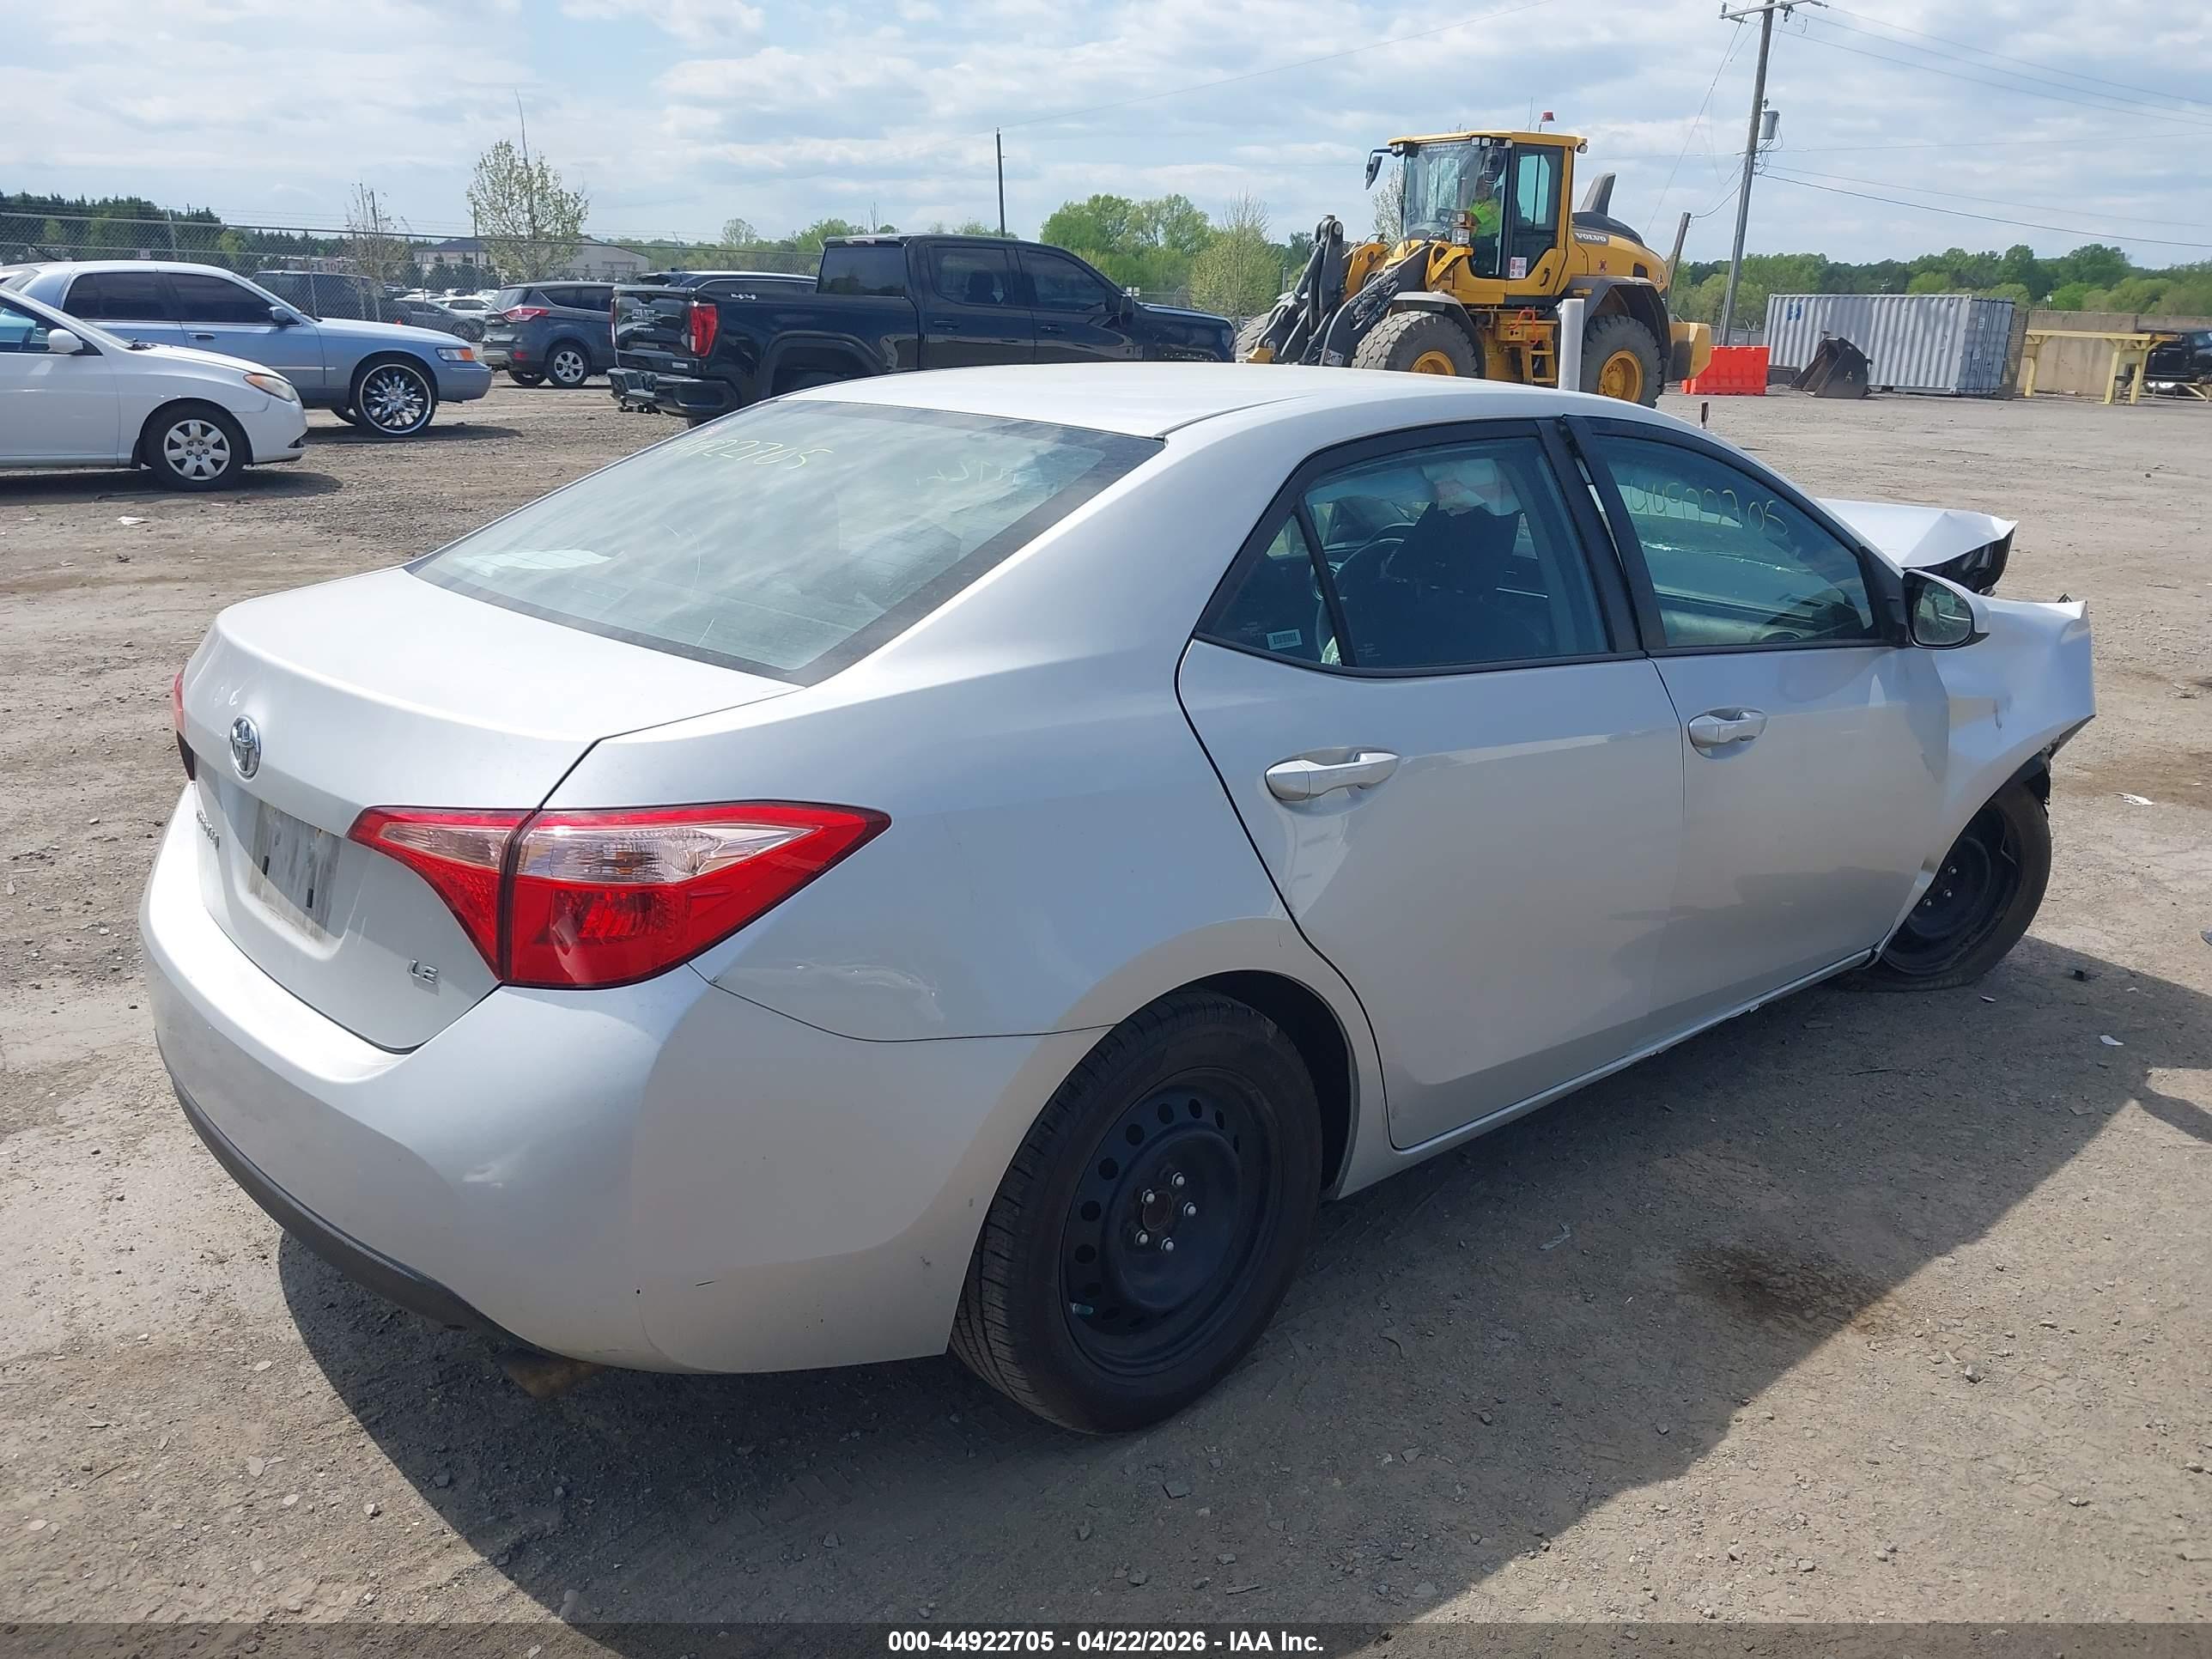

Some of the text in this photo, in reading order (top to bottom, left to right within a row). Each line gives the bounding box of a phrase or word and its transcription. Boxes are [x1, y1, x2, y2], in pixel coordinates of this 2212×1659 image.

[1574, 232, 1607, 242] VOLVO
[1348, 299, 1358, 308] NO
[1368, 313, 1378, 325] DEL
[407, 959, 440, 984] LE
